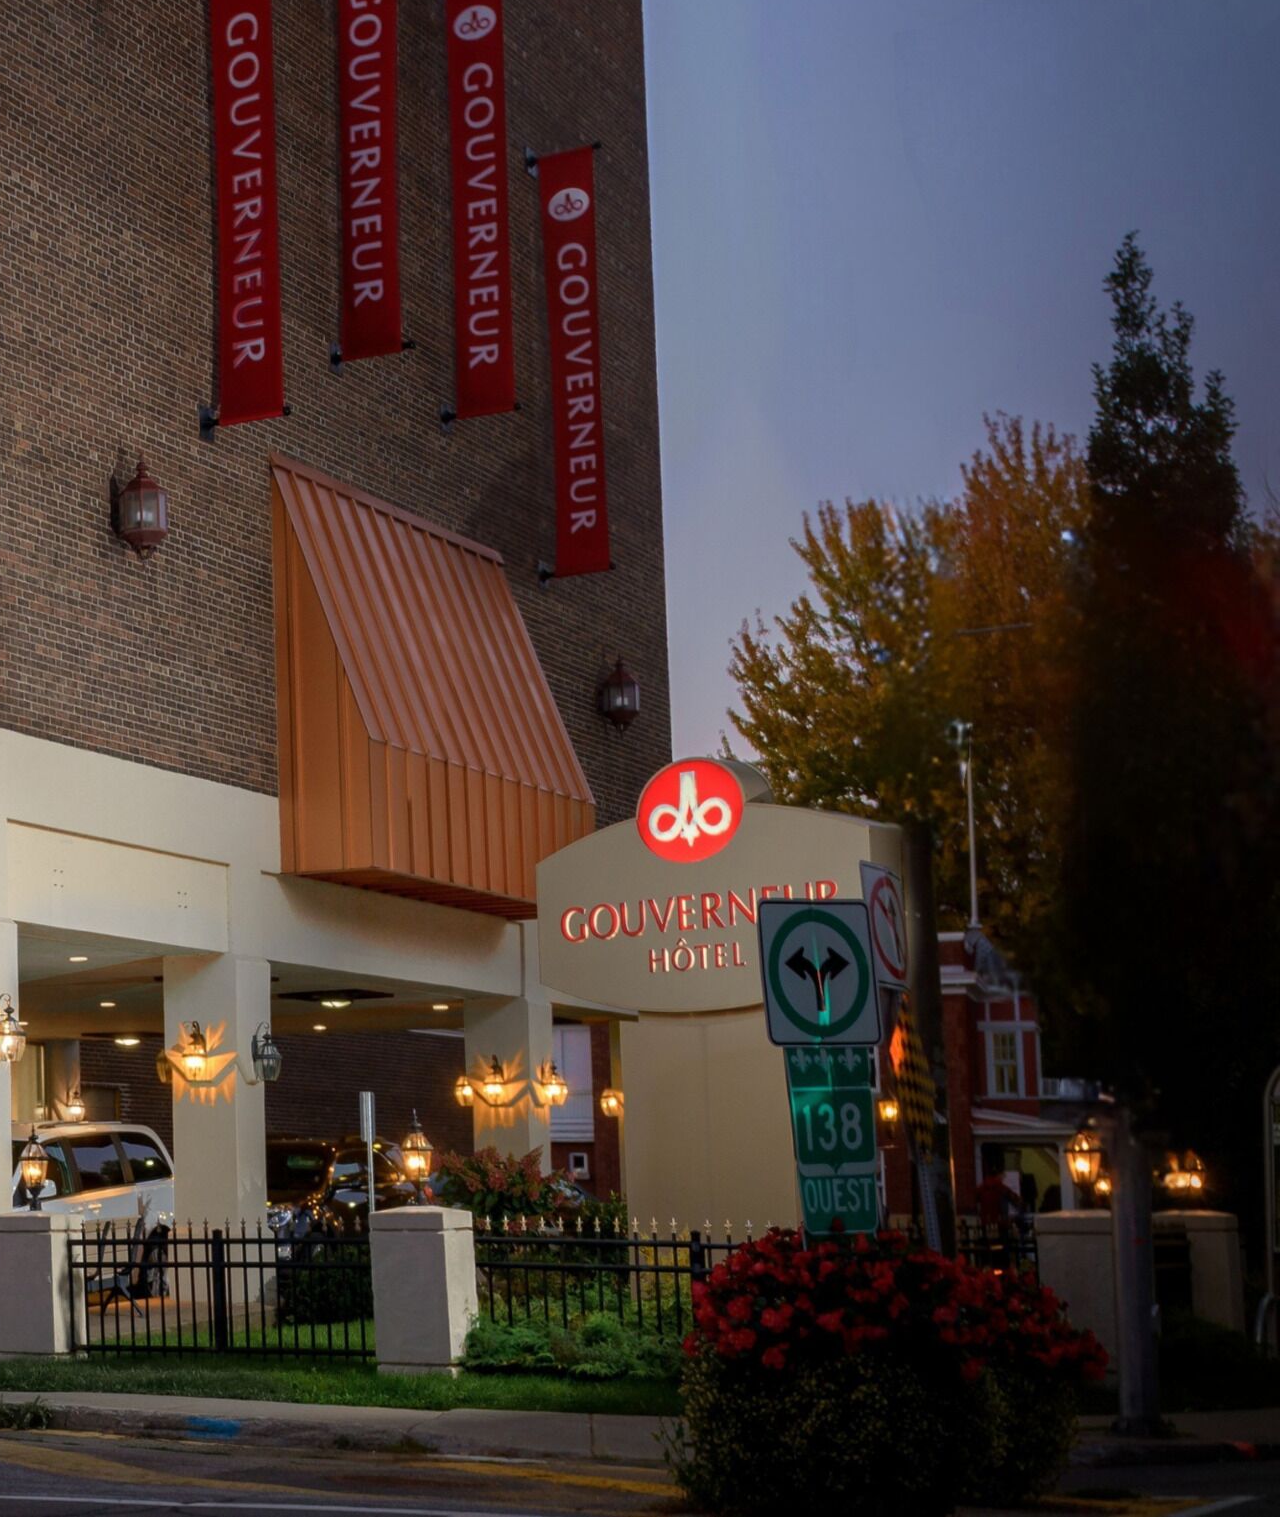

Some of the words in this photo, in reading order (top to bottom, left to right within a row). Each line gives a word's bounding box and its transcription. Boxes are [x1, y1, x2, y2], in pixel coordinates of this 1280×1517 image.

[226, 12, 266, 367] GOUVERNEUR
[463, 62, 499, 369] GOUVERNEUR
[557, 242, 598, 535] GOUVERNEUR
[649, 937, 746, 973] HÔTEL
[802, 1102, 863, 1151] 138
[804, 1176, 873, 1215] OUEST
